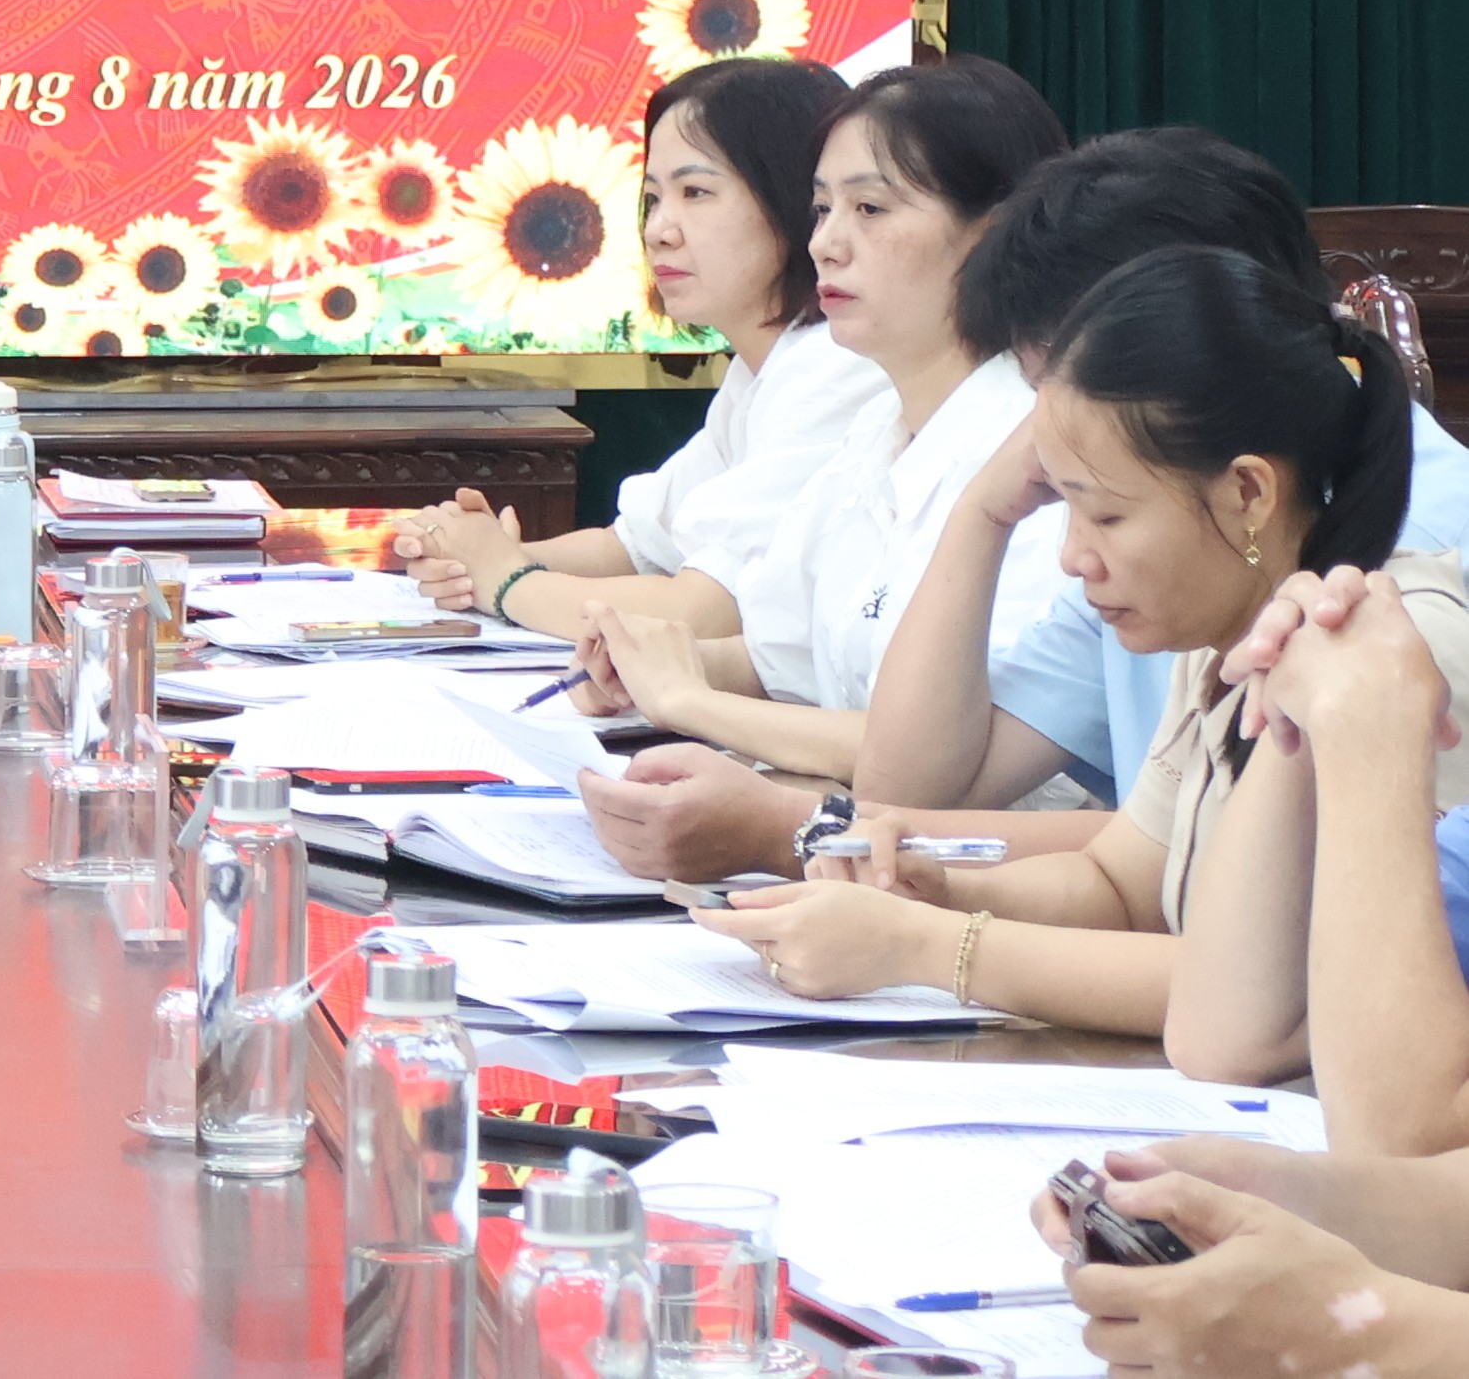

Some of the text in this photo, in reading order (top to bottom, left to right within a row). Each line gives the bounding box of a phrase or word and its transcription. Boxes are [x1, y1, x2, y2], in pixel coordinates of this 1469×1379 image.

[92, 55, 131, 111] 8
[147, 55, 285, 112] năm
[307, 54, 457, 112] 2026
